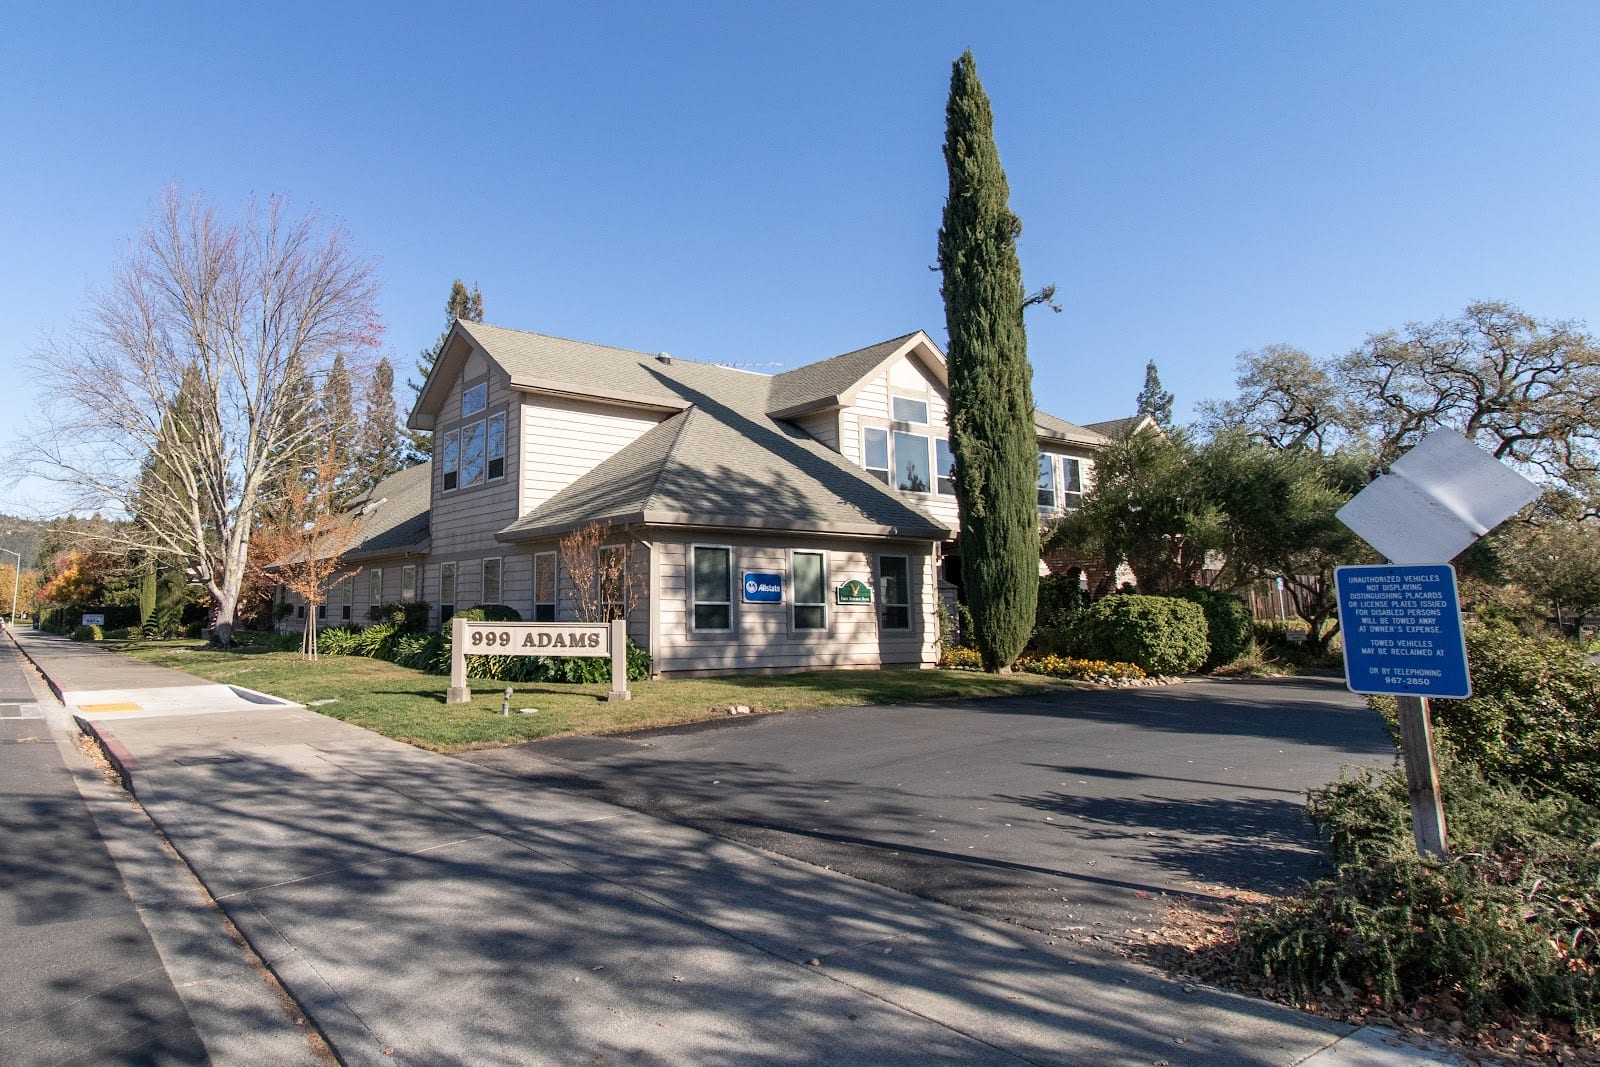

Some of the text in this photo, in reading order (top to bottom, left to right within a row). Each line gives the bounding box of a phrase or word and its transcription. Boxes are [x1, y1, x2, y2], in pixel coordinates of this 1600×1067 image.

[758, 584, 780, 592] Allstate
[471, 631, 600, 648] 999 ADAMS
[1391, 648, 1433, 656] RECLAIMED
[1394, 668, 1442, 677] TELEPHONING
[1385, 677, 1430, 685] 967-2850
